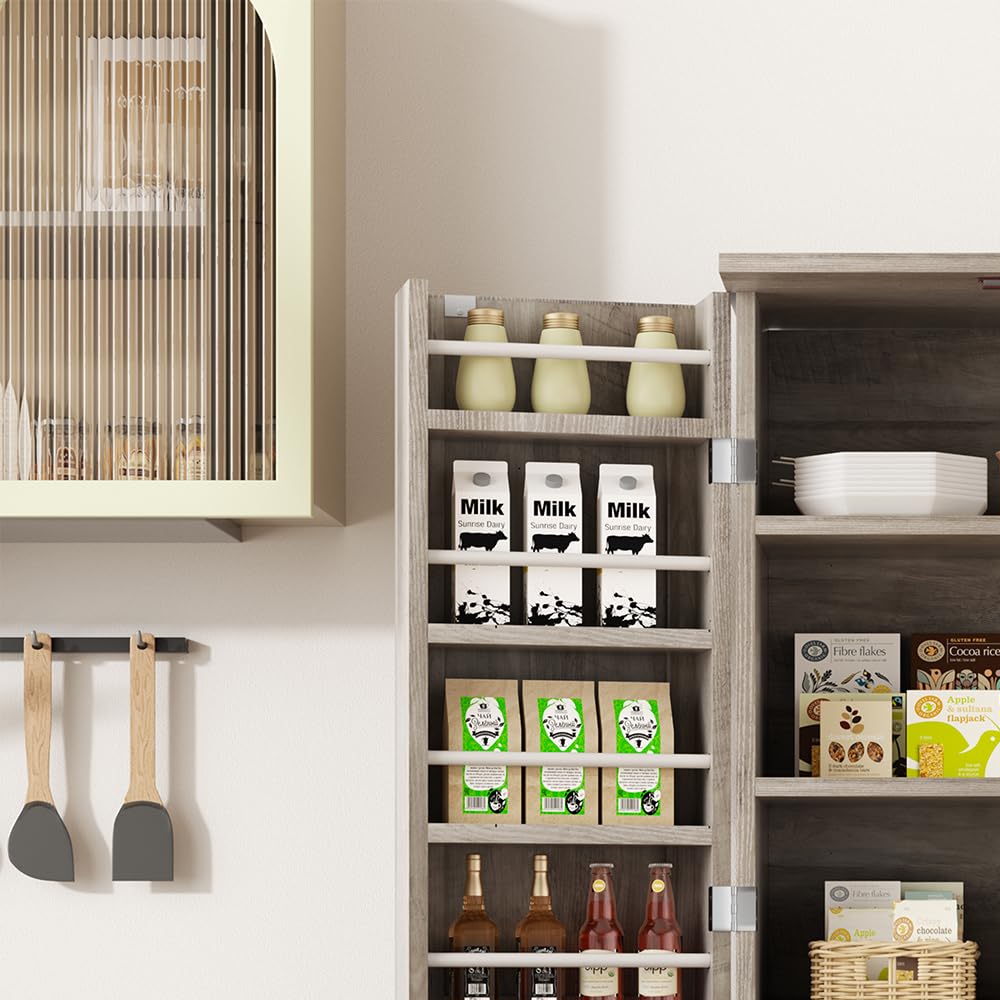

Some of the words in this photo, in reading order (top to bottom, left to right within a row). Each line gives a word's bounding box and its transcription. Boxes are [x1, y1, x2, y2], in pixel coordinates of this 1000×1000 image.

[461, 499, 504, 515] Milk
[534, 501, 576, 517] Milk
[608, 502, 650, 518] Milk
[458, 520, 485, 528] Sunrise
[559, 522, 577, 530] Dairy
[633, 524, 651, 532] Dairy
[834, 646, 857, 656] Fibre
[859, 646, 886, 656] flakes
[950, 646, 980, 656] Cocoa
[984, 646, 1000, 656] rice
[947, 696, 975, 704] Apple
[947, 715, 986, 724] flapjack
[854, 929, 877, 938] Apple
[917, 925, 952, 934] chocolate
